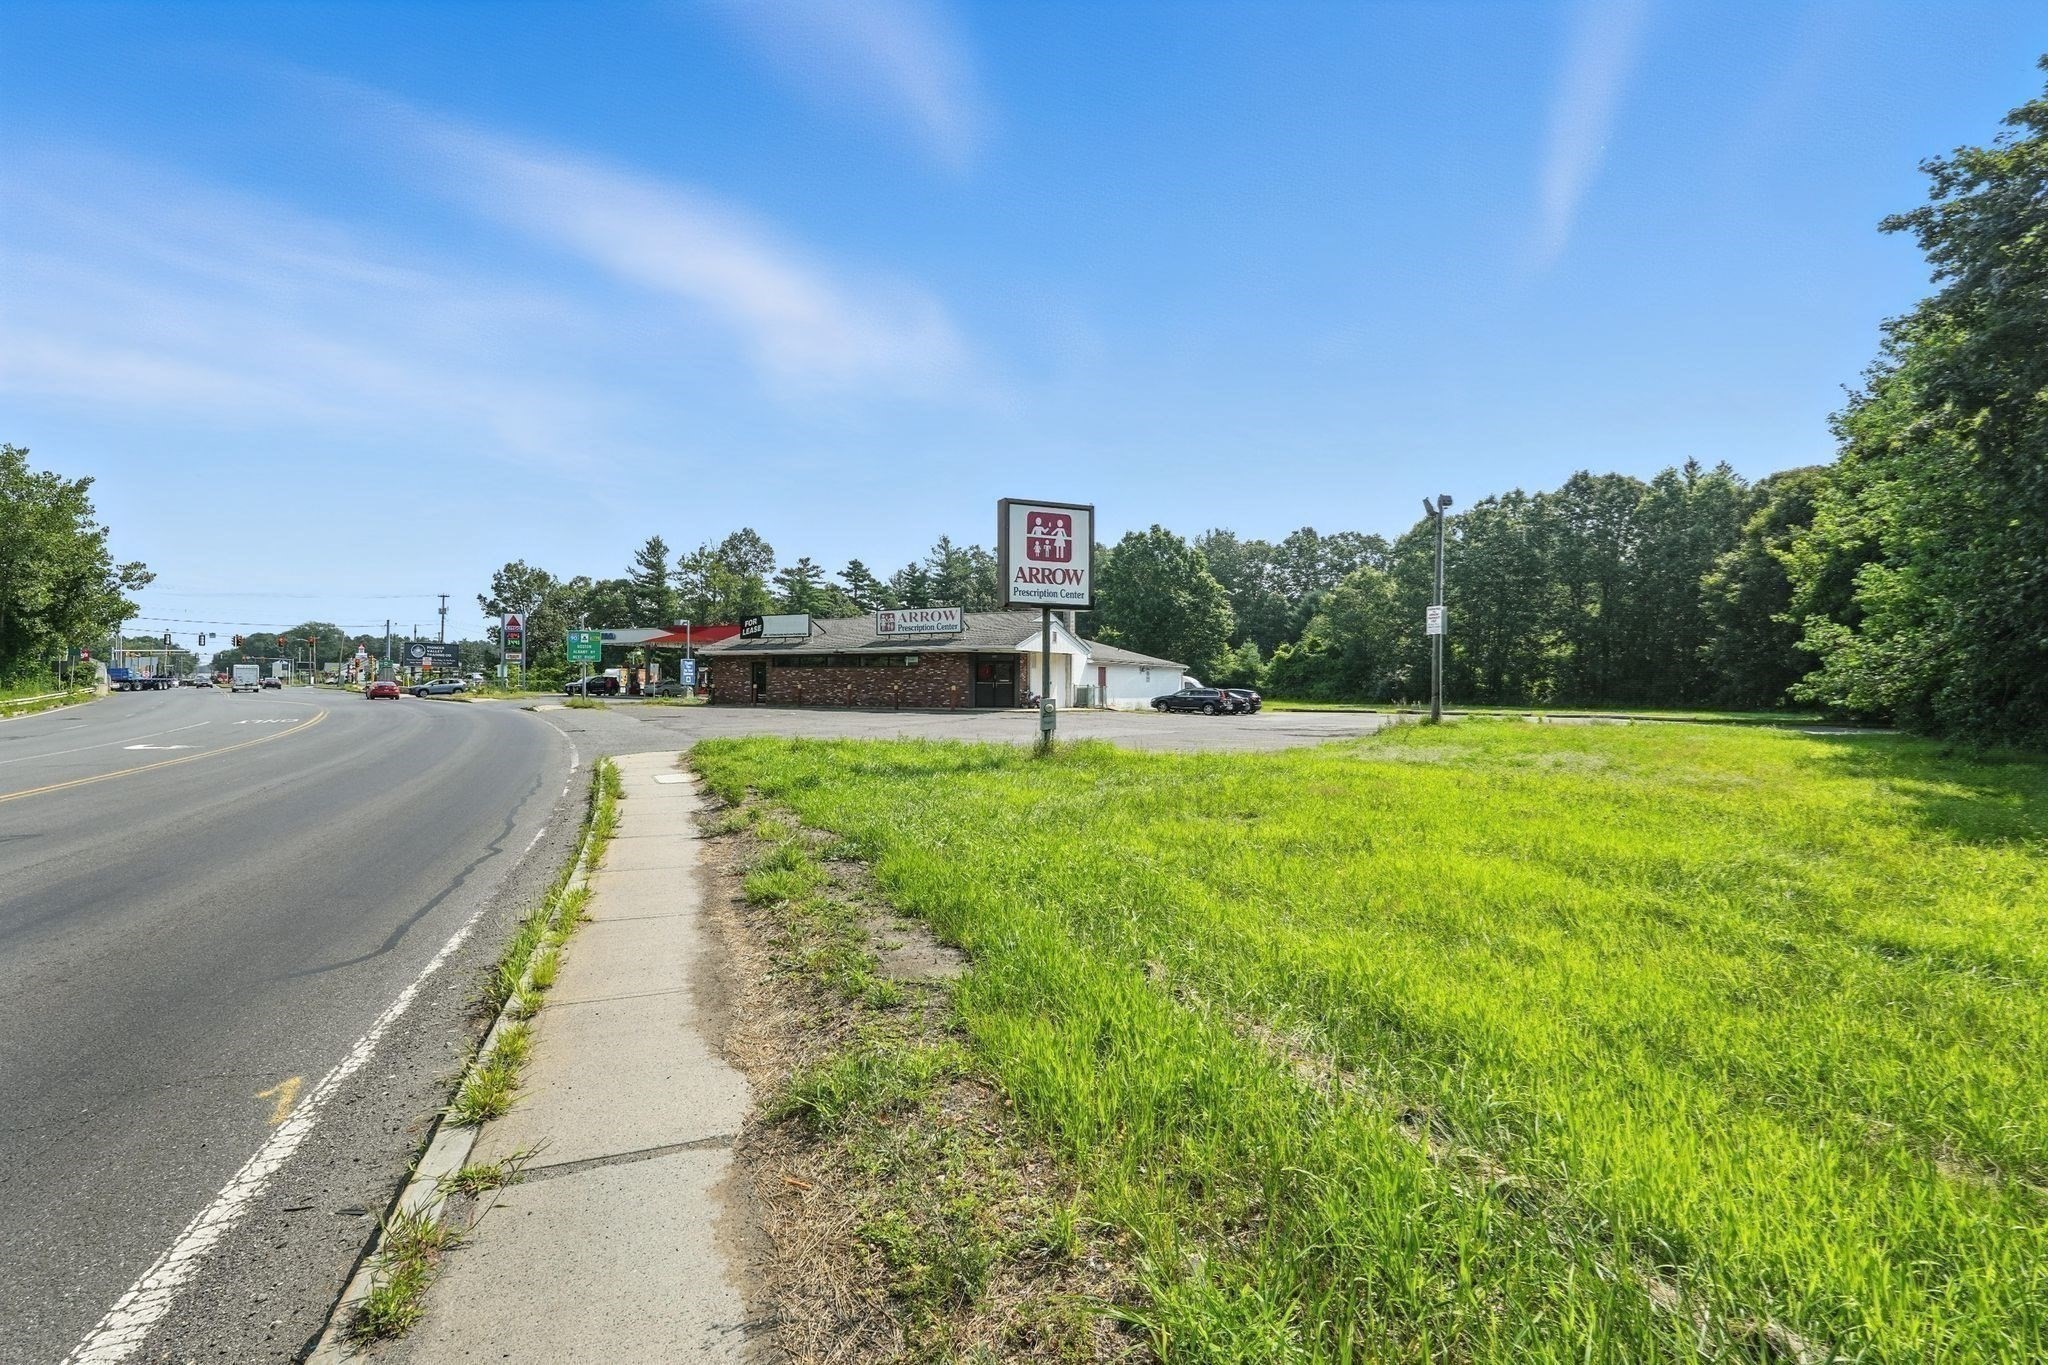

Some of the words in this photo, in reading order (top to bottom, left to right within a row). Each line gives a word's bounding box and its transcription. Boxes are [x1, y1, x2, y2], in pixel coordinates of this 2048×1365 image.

[1013, 566, 1085, 586] ARROW
[1013, 586, 1058, 599] Prescription
[1060, 589, 1085, 599] Center
[897, 610, 958, 623] ARROW
[744, 618, 758, 628] FOR
[897, 624, 935, 632] Prescription
[936, 622, 958, 631] Center
[742, 624, 762, 636] LEASE
